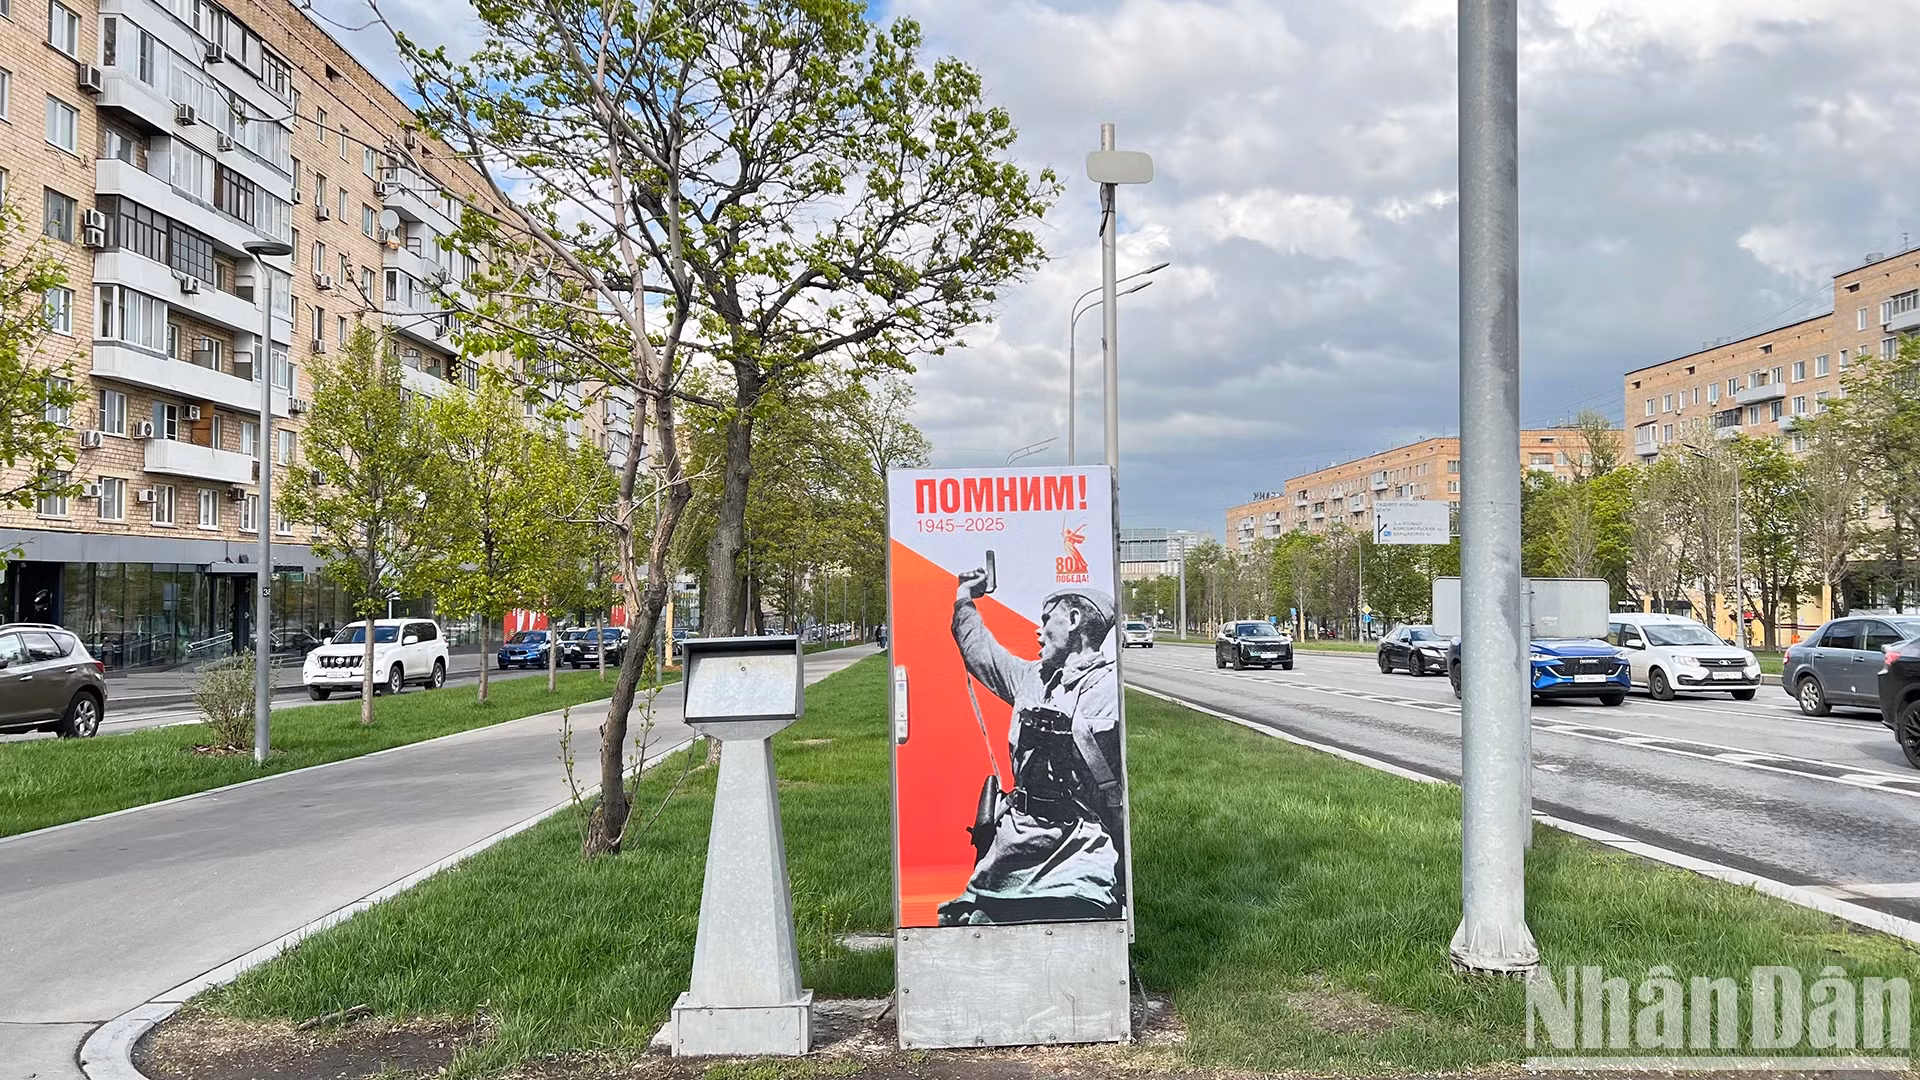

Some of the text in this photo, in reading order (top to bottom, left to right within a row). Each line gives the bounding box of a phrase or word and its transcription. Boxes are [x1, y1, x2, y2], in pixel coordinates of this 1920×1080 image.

[915, 475, 1087, 514] ПОМНИМ!
[1056, 556, 1073, 572] 80
[1056, 574, 1089, 583] ПОБЕДА!
